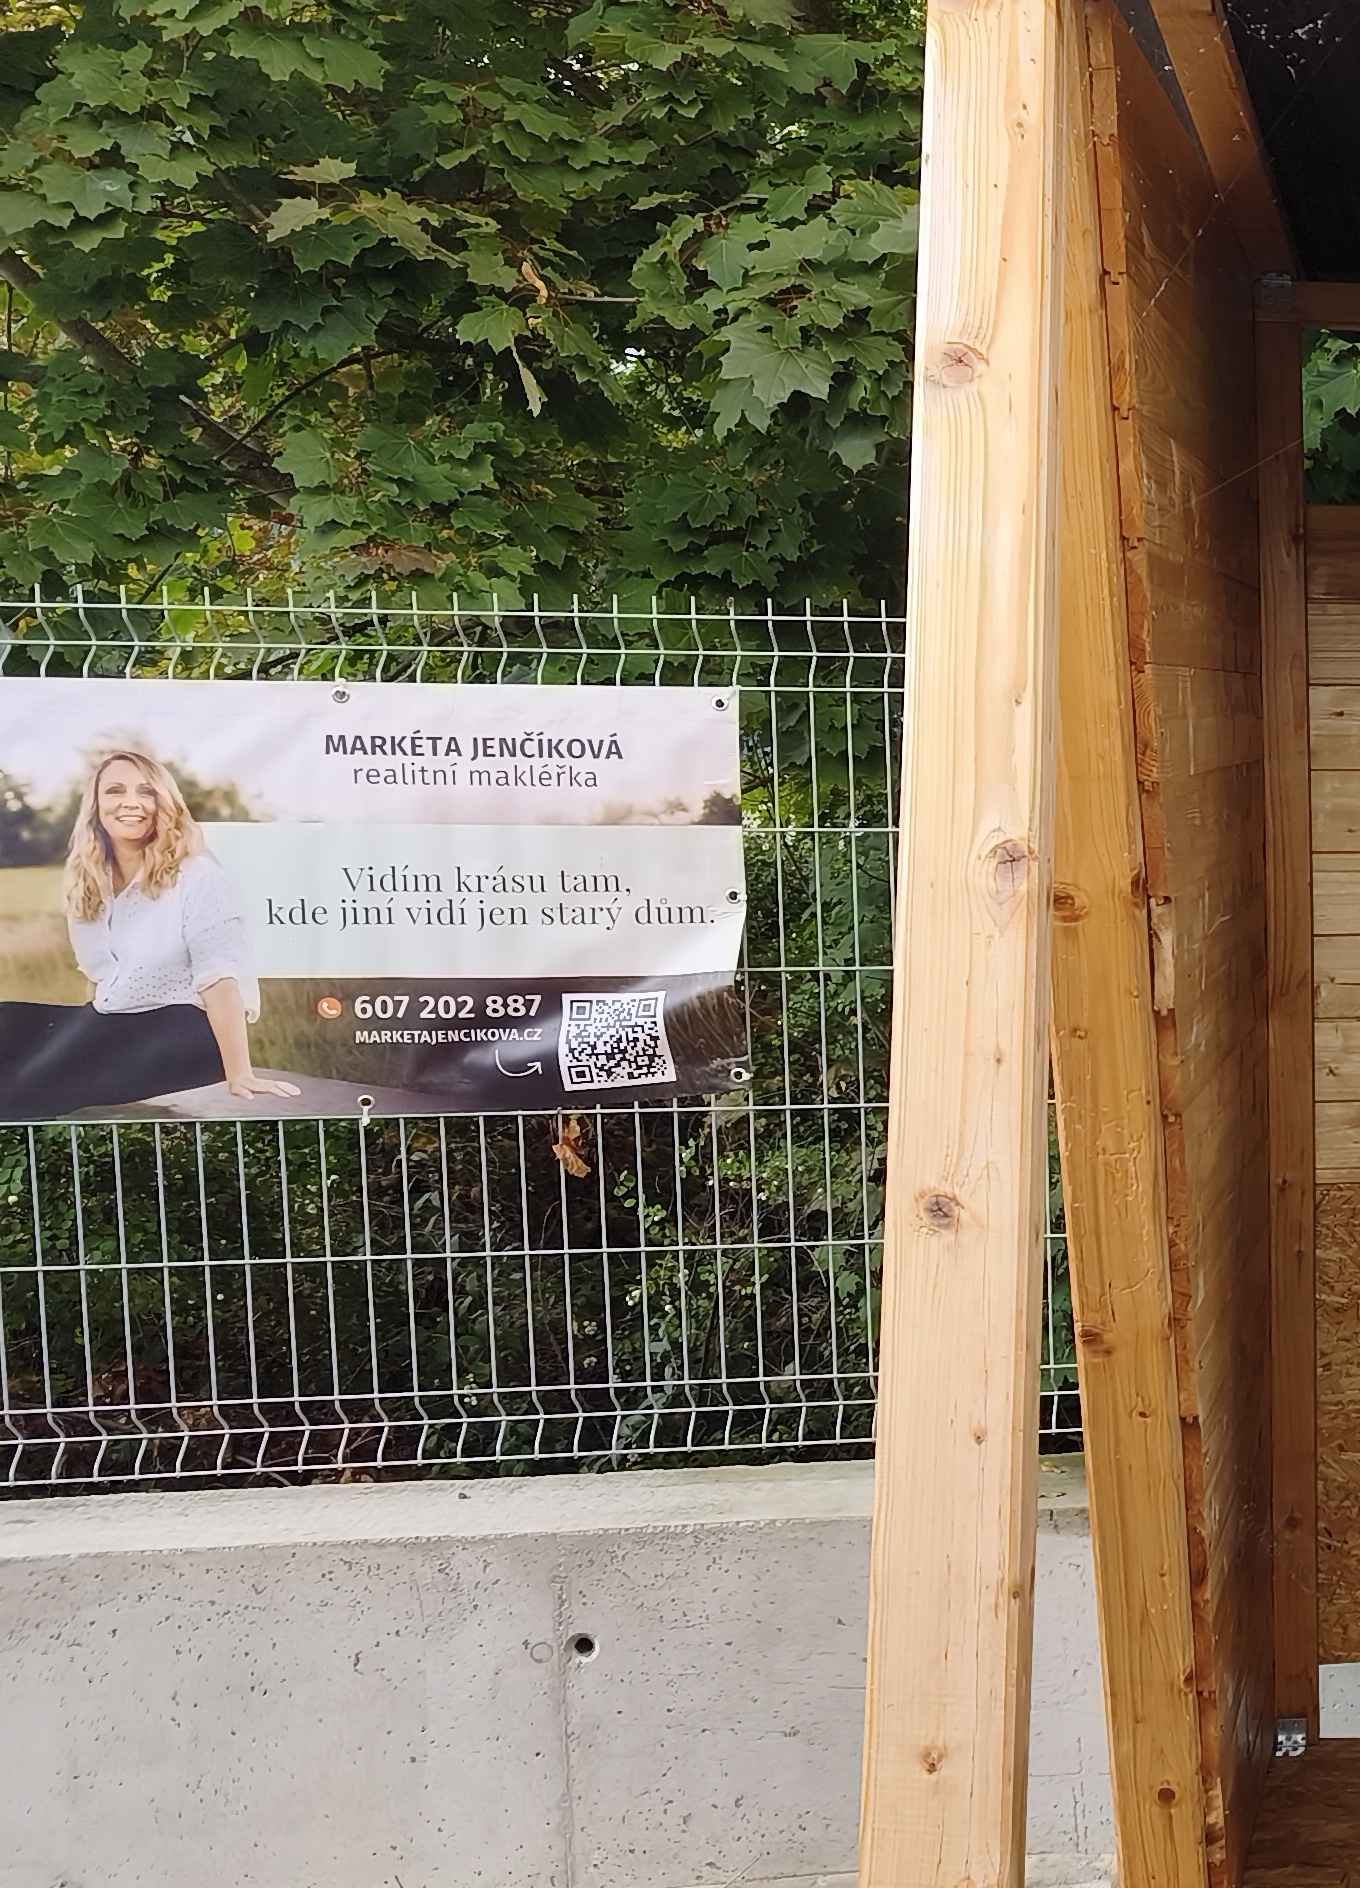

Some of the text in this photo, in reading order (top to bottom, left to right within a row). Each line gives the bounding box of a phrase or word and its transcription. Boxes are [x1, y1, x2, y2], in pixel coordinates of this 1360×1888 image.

[325, 730, 624, 761] MARKÉTA JENČÍKOVÁ
[353, 762, 599, 788] realitní makléřka
[342, 864, 632, 897] Vidím krásu tam,
[266, 897, 715, 932] kde jiní vidí jen starý dům.
[354, 994, 542, 1019] 607 202 887
[355, 1028, 543, 1046] MARKETAJENCIKOVA.CZ
